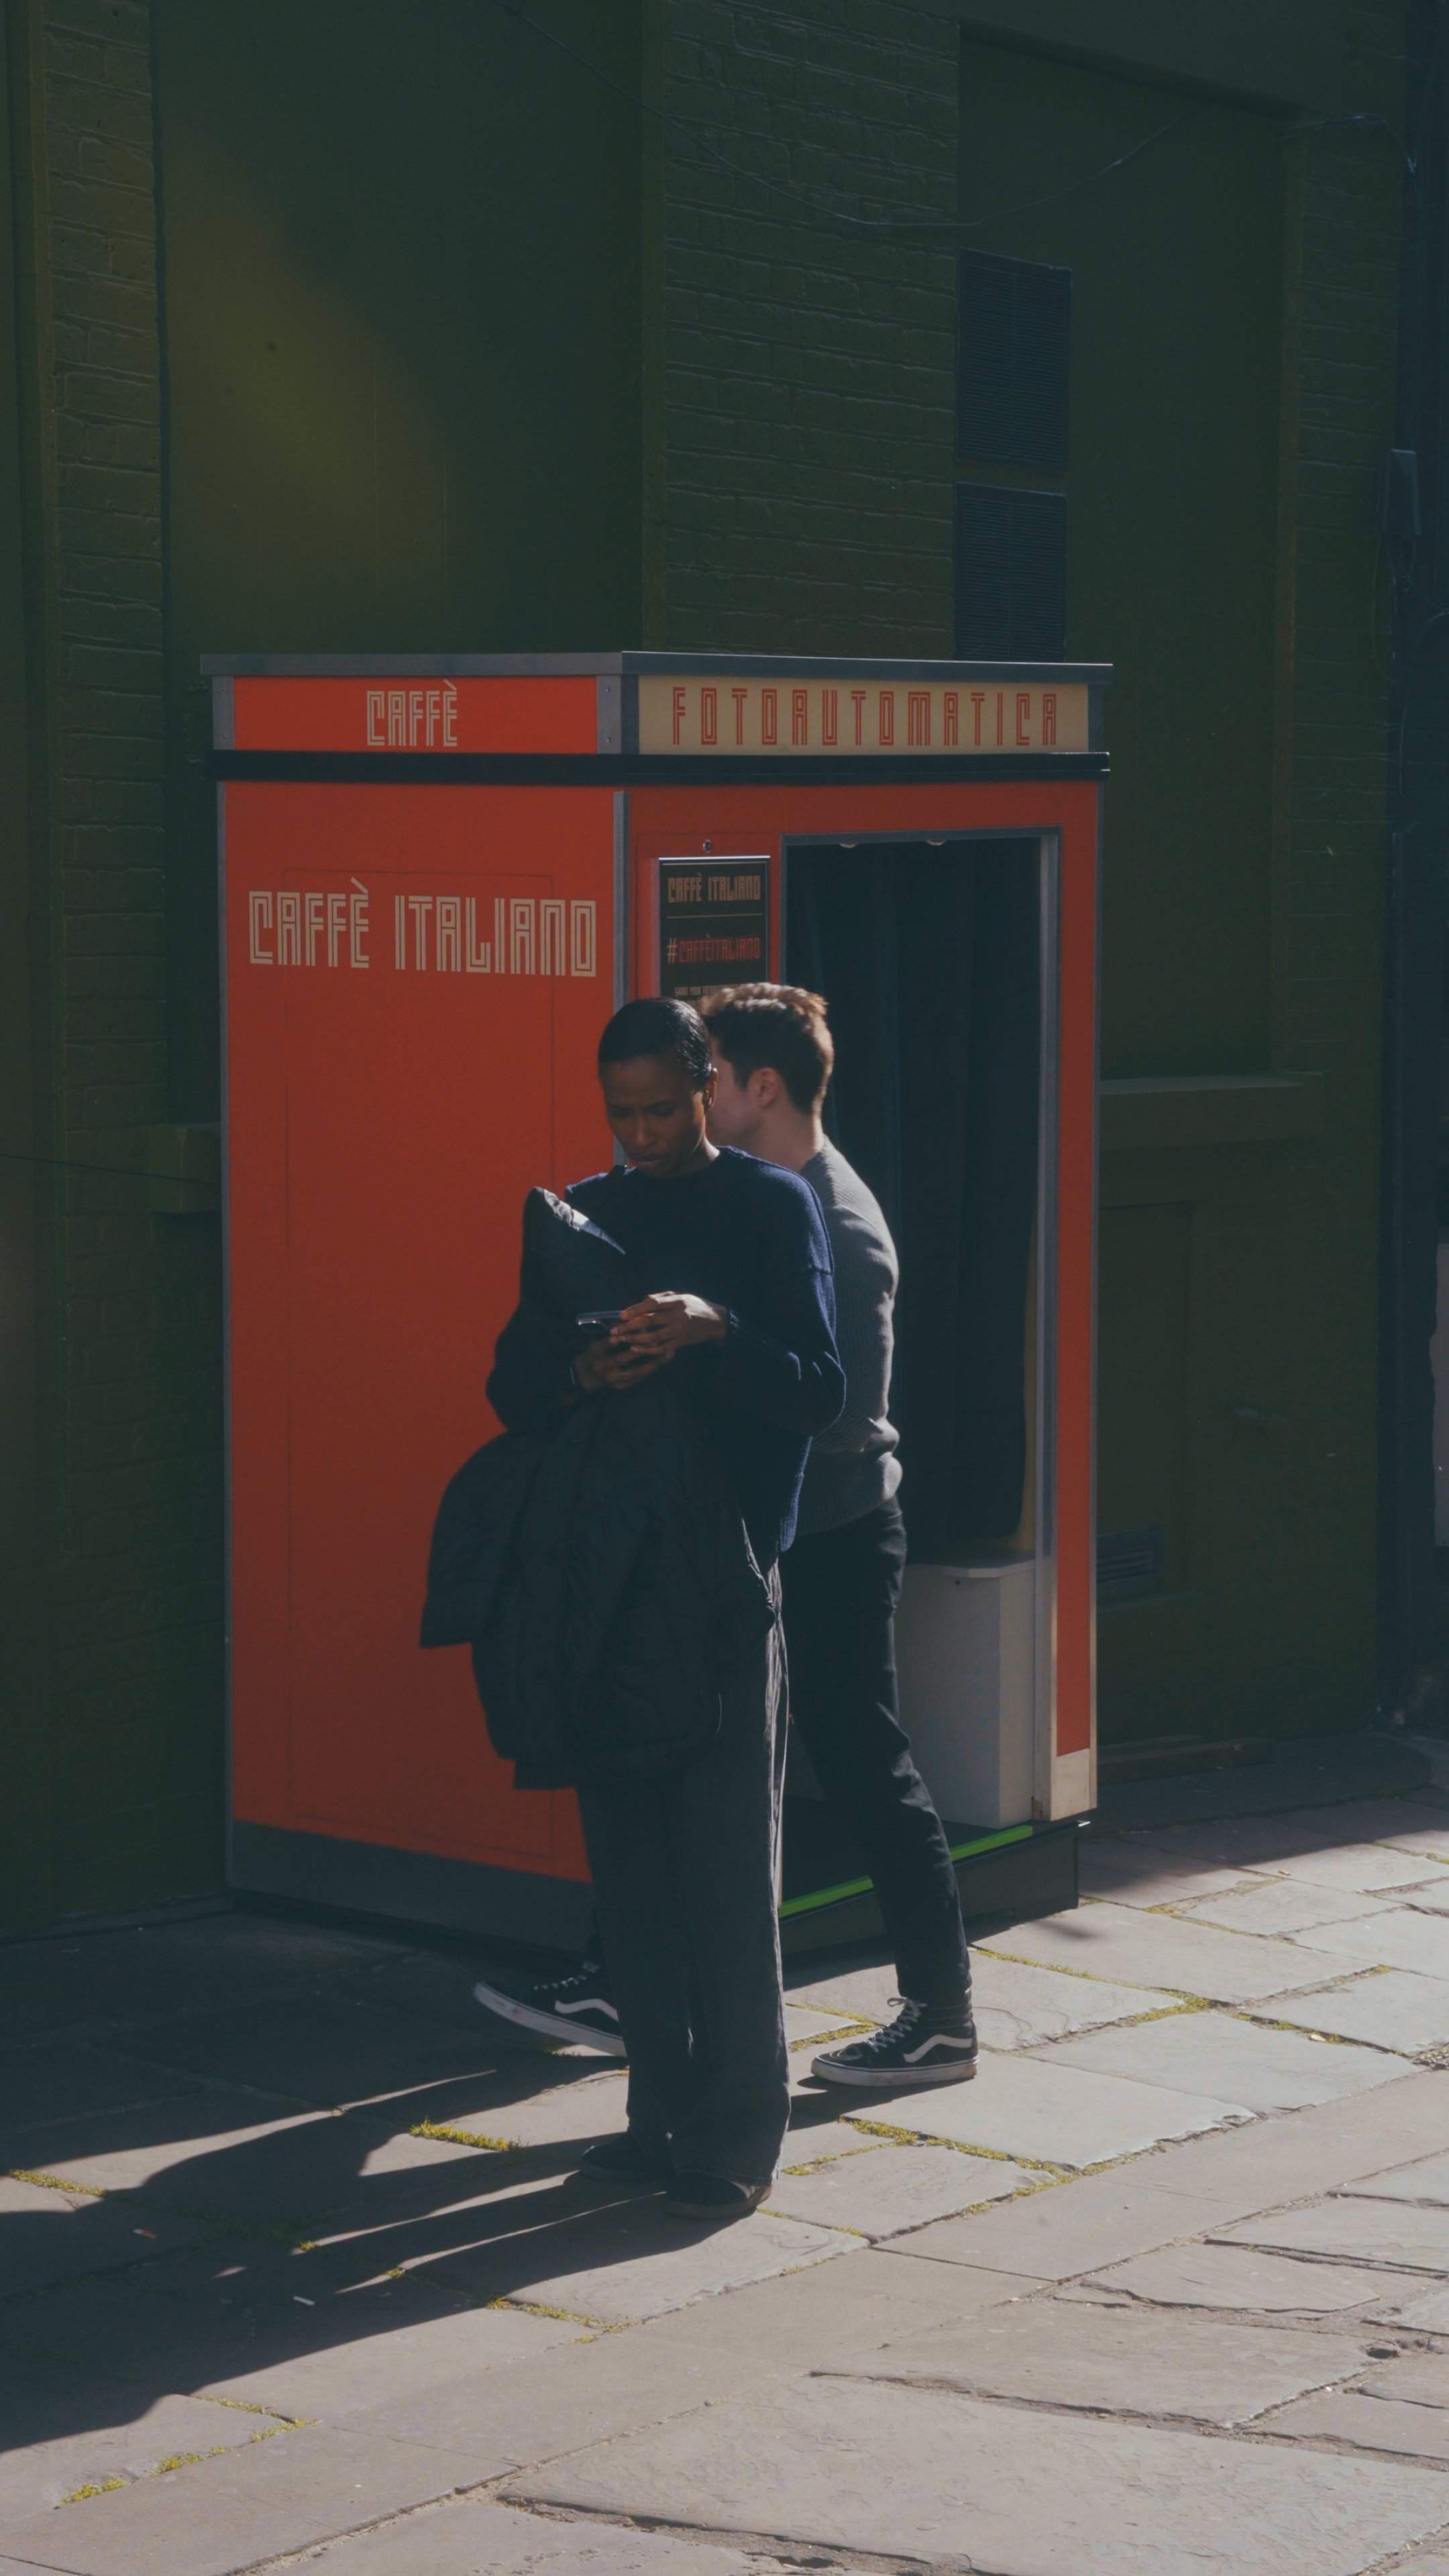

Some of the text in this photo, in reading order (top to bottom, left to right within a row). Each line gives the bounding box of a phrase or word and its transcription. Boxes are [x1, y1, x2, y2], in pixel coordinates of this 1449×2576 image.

[366, 679, 458, 747] CAFFÈ
[672, 686, 1057, 746] FOTOAUTOMATICA
[667, 871, 761, 903] CAFFÈ ITALIANO
[249, 877, 596, 977] CAFFÈ ITALIANO
[667, 933, 761, 963] #CAFFÈITALIANO
